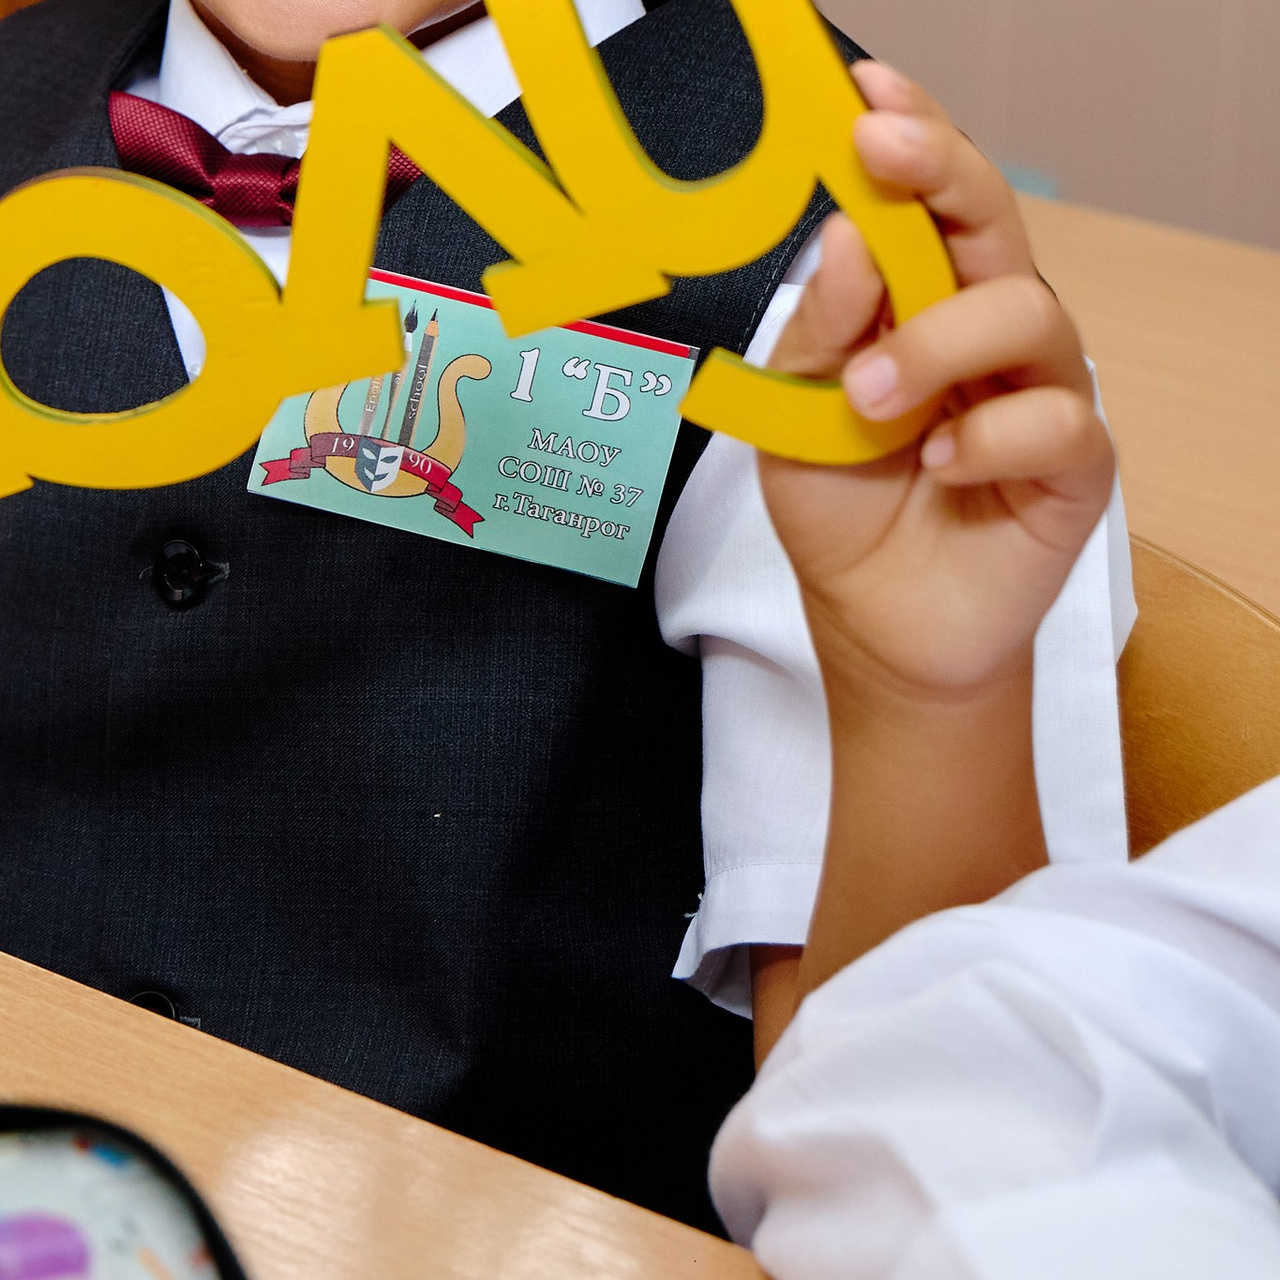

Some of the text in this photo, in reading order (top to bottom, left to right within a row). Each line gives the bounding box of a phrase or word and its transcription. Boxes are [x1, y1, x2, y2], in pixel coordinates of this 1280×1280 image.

[408, 363, 428, 421] school
[509, 348, 541, 403] 1
[331, 435, 432, 475] 19 90
[527, 428, 621, 468] МАОУ
[498, 456, 644, 509] СОШ № 37
